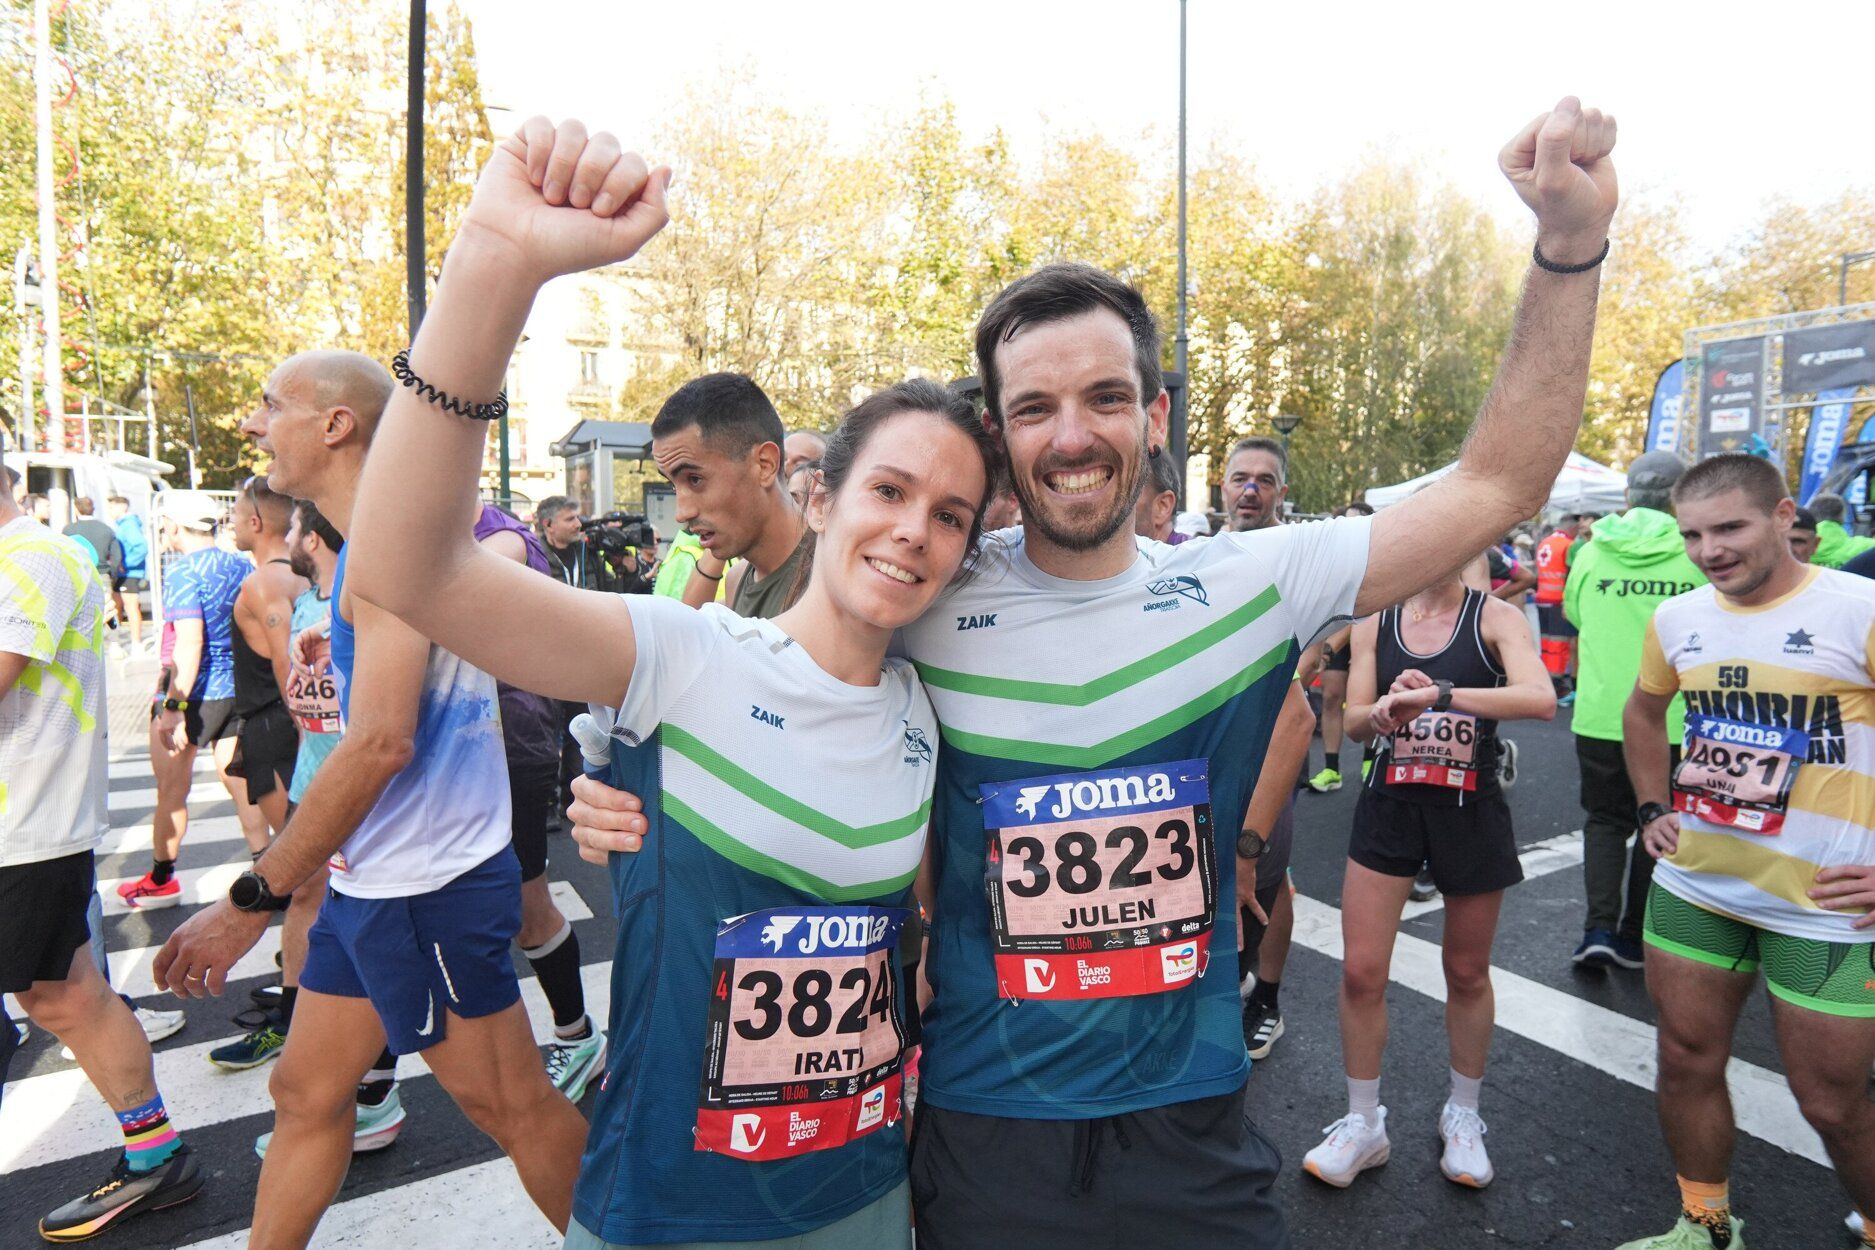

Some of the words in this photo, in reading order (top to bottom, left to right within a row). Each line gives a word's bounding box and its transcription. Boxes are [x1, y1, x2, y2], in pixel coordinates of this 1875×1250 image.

[957, 613, 998, 631] ZAIK
[1718, 665, 1749, 688] 59
[290, 678, 336, 700] 246
[750, 704, 785, 730] ZAIK
[1395, 716, 1473, 745] 4566
[1412, 746, 1453, 757] NEREA
[989, 839, 1000, 865] 4
[1006, 819, 1194, 898] 3823
[1062, 899, 1156, 928] JULEN
[1181, 922, 1200, 933] delta
[1064, 936, 1092, 951] 10:06h
[1077, 959, 1089, 969] EL
[1078, 966, 1110, 977] DIARIO
[715, 970, 728, 1000] 4
[1079, 974, 1111, 986] VASCO
[733, 960, 889, 1041] 3824
[782, 1084, 809, 1101] 10:06h
[790, 1111, 801, 1121] EL
[789, 1118, 821, 1132] DIARIO
[789, 1128, 818, 1142] VASCO
